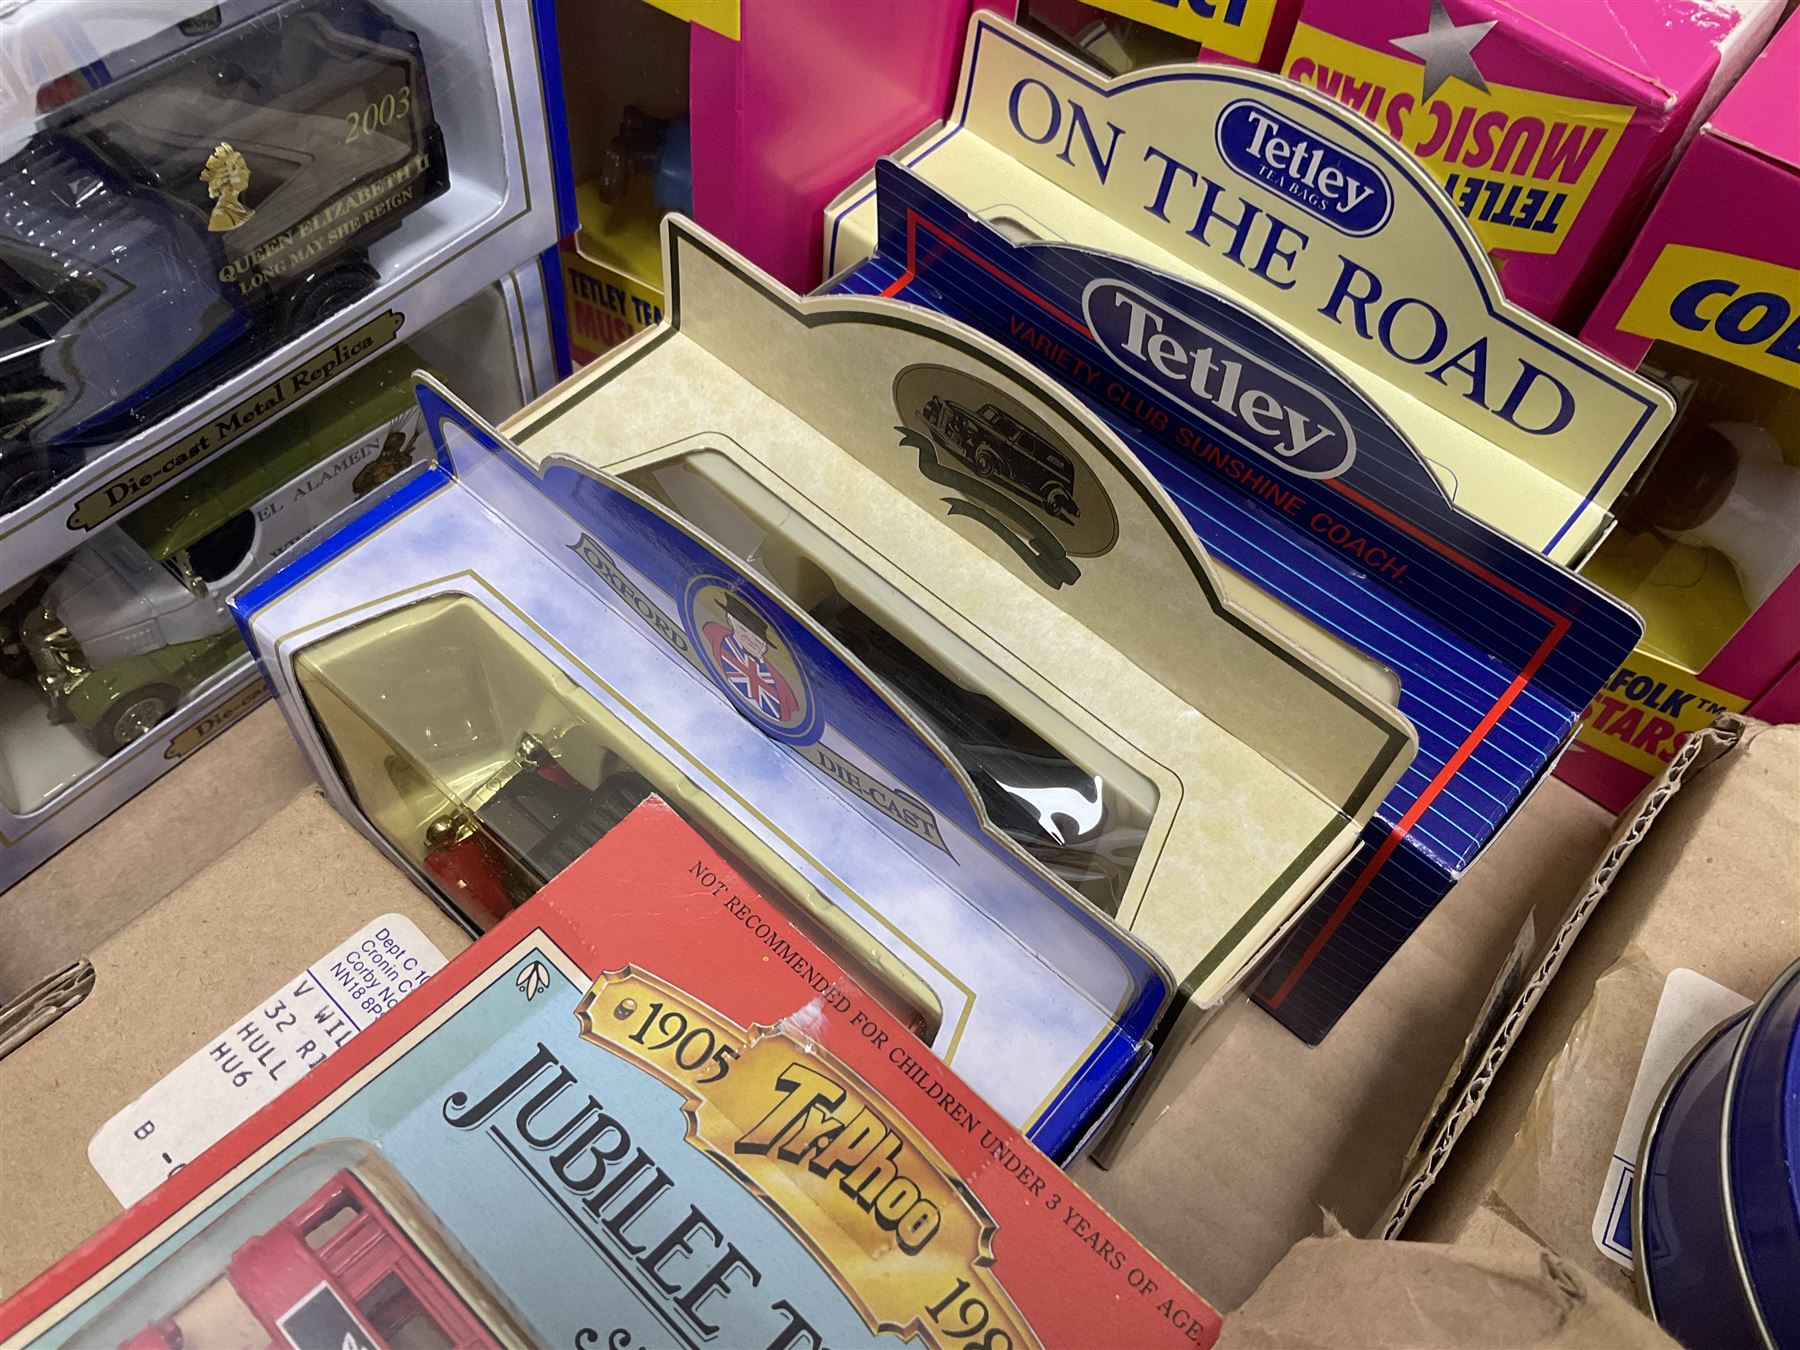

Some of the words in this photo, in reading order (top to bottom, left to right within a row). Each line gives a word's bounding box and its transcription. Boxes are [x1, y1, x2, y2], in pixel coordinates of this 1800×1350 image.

[345, 86, 411, 144] 2003
[1415, 100, 1608, 184] MUSIC
[1247, 112, 1375, 212] Tetley
[1258, 165, 1285, 188] TEA
[1289, 180, 1330, 211] BAGS
[219, 229, 294, 282] QUEEN
[299, 166, 411, 238] ELIZABETH
[416, 153, 431, 173] II
[238, 262, 288, 296] LONG
[291, 236, 325, 272] MAY
[328, 216, 362, 242] SHE
[363, 187, 414, 224] REIGN
[1008, 78, 1126, 185] ON
[1144, 146, 1309, 290] THE
[1317, 254, 1576, 435] ROAD
[568, 267, 627, 317] TETLEY
[1115, 291, 1335, 457] Tetley
[103, 435, 210, 508] Die-cast
[214, 385, 287, 441] Metal
[289, 335, 375, 394] Replica
[1009, 316, 1100, 384] VARIETY
[1105, 382, 1169, 433] CLUB
[1176, 427, 1307, 517] SUNSHINE
[256, 502, 285, 522] EL
[293, 438, 382, 501] ALAMEIN
[583, 546, 690, 653] OXFORD
[814, 750, 936, 839] DIE-CAST
[293, 980, 315, 998] V
[330, 962, 366, 1000] NN18
[346, 951, 381, 989] Corby
[361, 940, 399, 982] Cronin
[375, 928, 406, 960] Dept
[403, 957, 418, 971] C
[236, 1021, 287, 1081] HULL
[264, 1000, 297, 1033] 32
[629, 1002, 740, 1084] 1905
[209, 1042, 253, 1088] HU6
[689, 859, 728, 898] NOT
[723, 894, 852, 1015] RECOMMENDED
[849, 1010, 888, 1053] FOR
[888, 1047, 981, 1135] CHILDREN
[980, 1130, 1047, 1198] UNDER
[1045, 1193, 1062, 1211] 3
[1062, 1207, 1127, 1271] YEARS
[1127, 1268, 1159, 1298] OF
[1157, 1297, 1207, 1347] AGE.
[134, 1120, 155, 1140] B
[442, 1041, 762, 1337] JUBILEE
